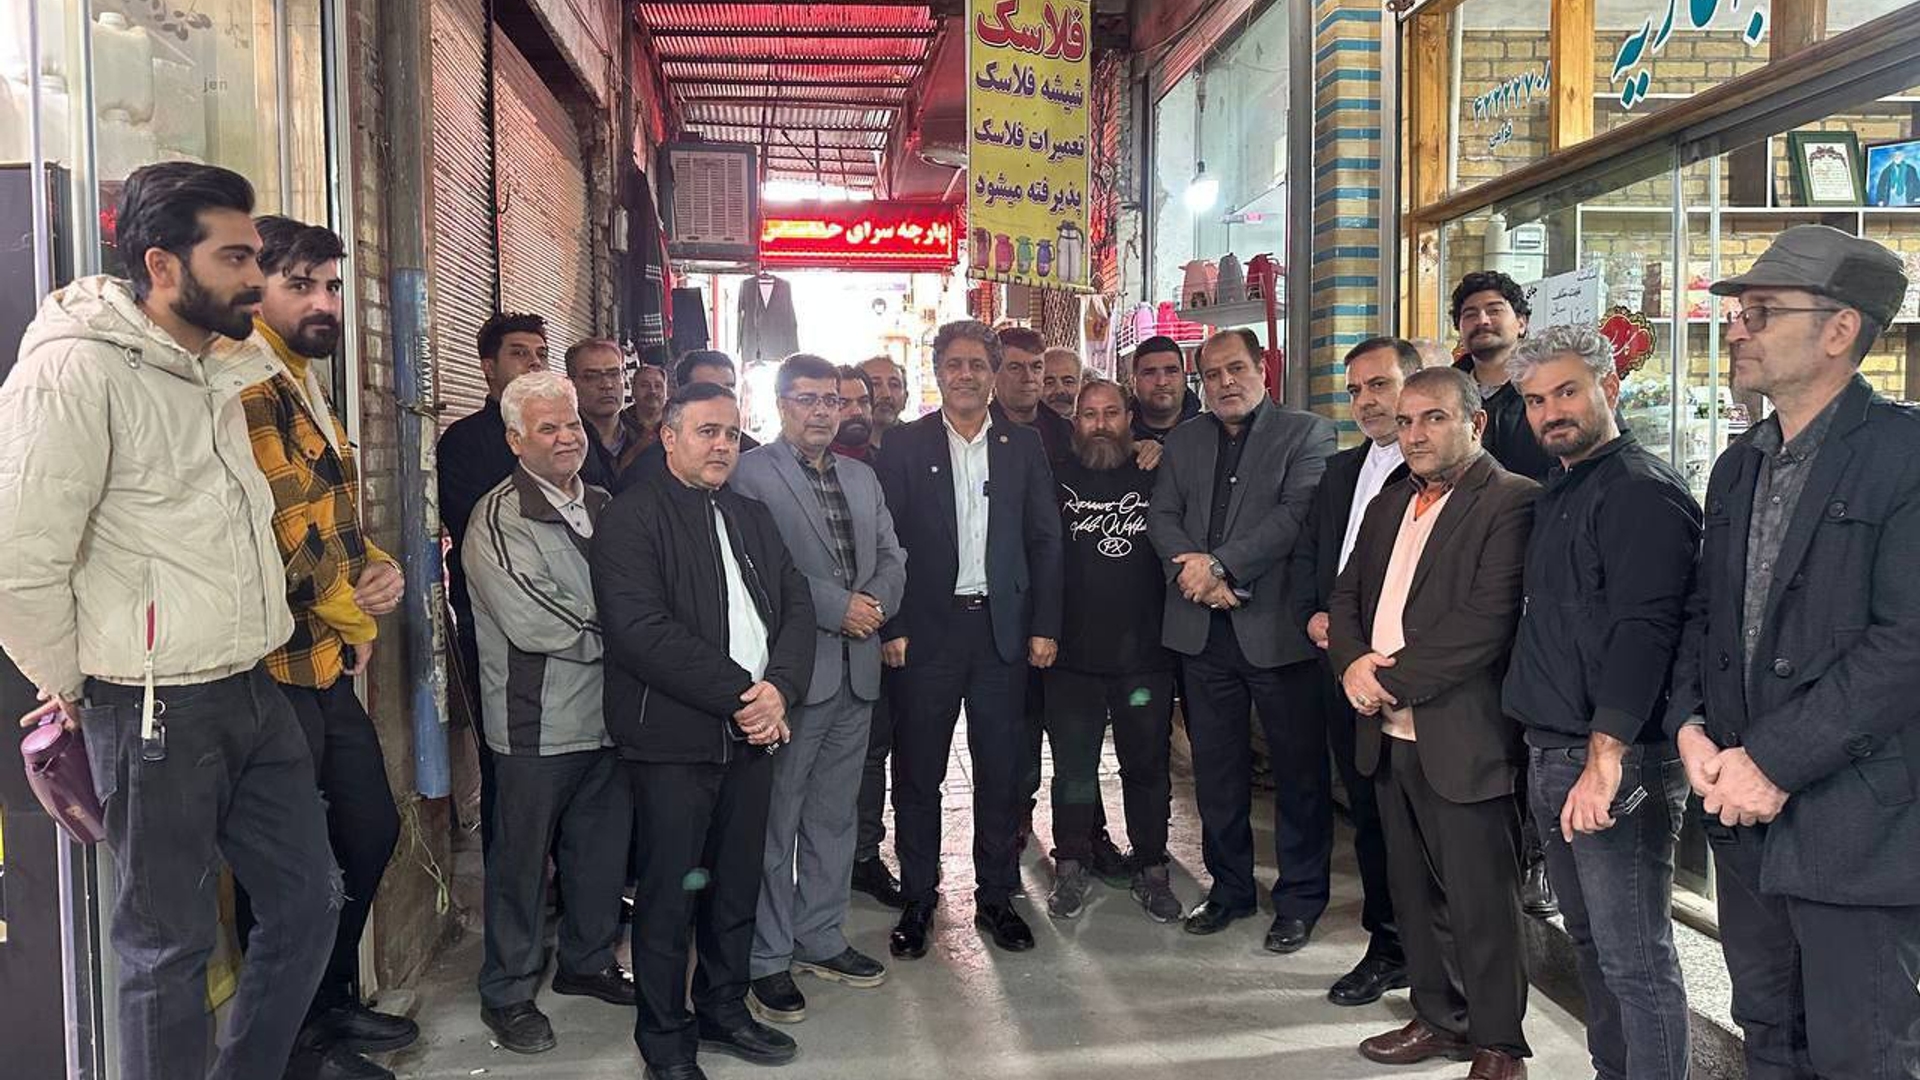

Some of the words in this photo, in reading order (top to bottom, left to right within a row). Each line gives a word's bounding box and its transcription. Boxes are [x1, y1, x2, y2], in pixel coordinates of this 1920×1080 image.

[1041, 75, 1084, 112] شیشه
[1028, 129, 1086, 162] تعمیرات
[975, 173, 1023, 206] میشود
[1027, 177, 1082, 216] پذیرفته
[846, 221, 894, 245] سرای
